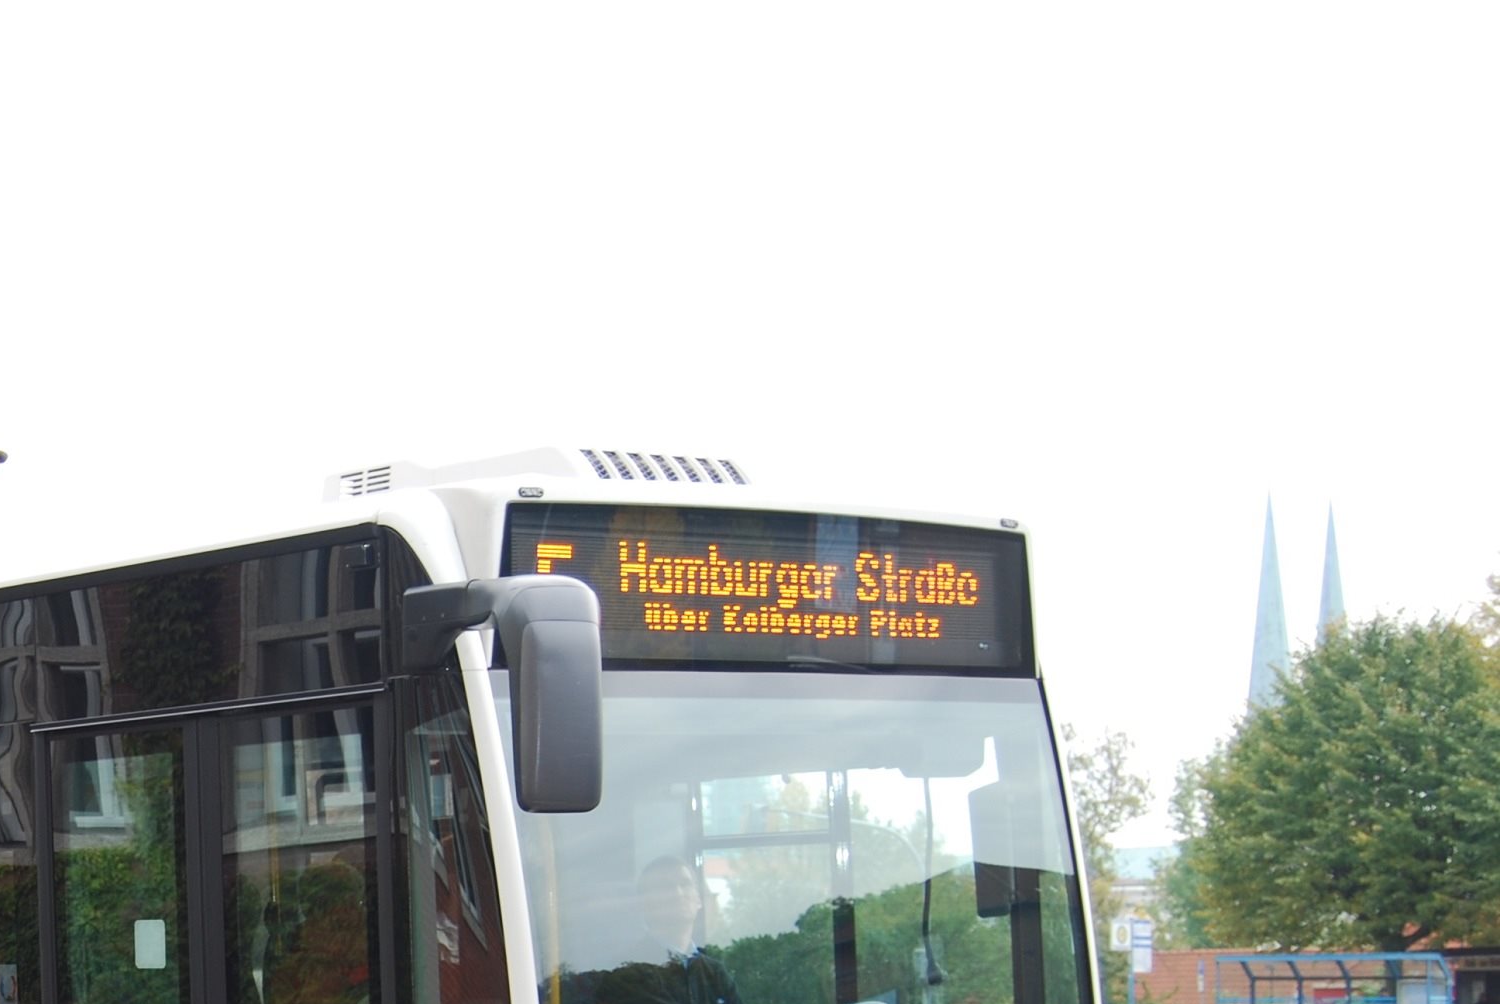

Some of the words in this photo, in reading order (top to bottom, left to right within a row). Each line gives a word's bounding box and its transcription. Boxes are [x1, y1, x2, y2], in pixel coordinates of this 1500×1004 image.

[619, 541, 837, 608] Hamburger
[854, 552, 978, 606] Straße
[870, 610, 940, 638] Platz
